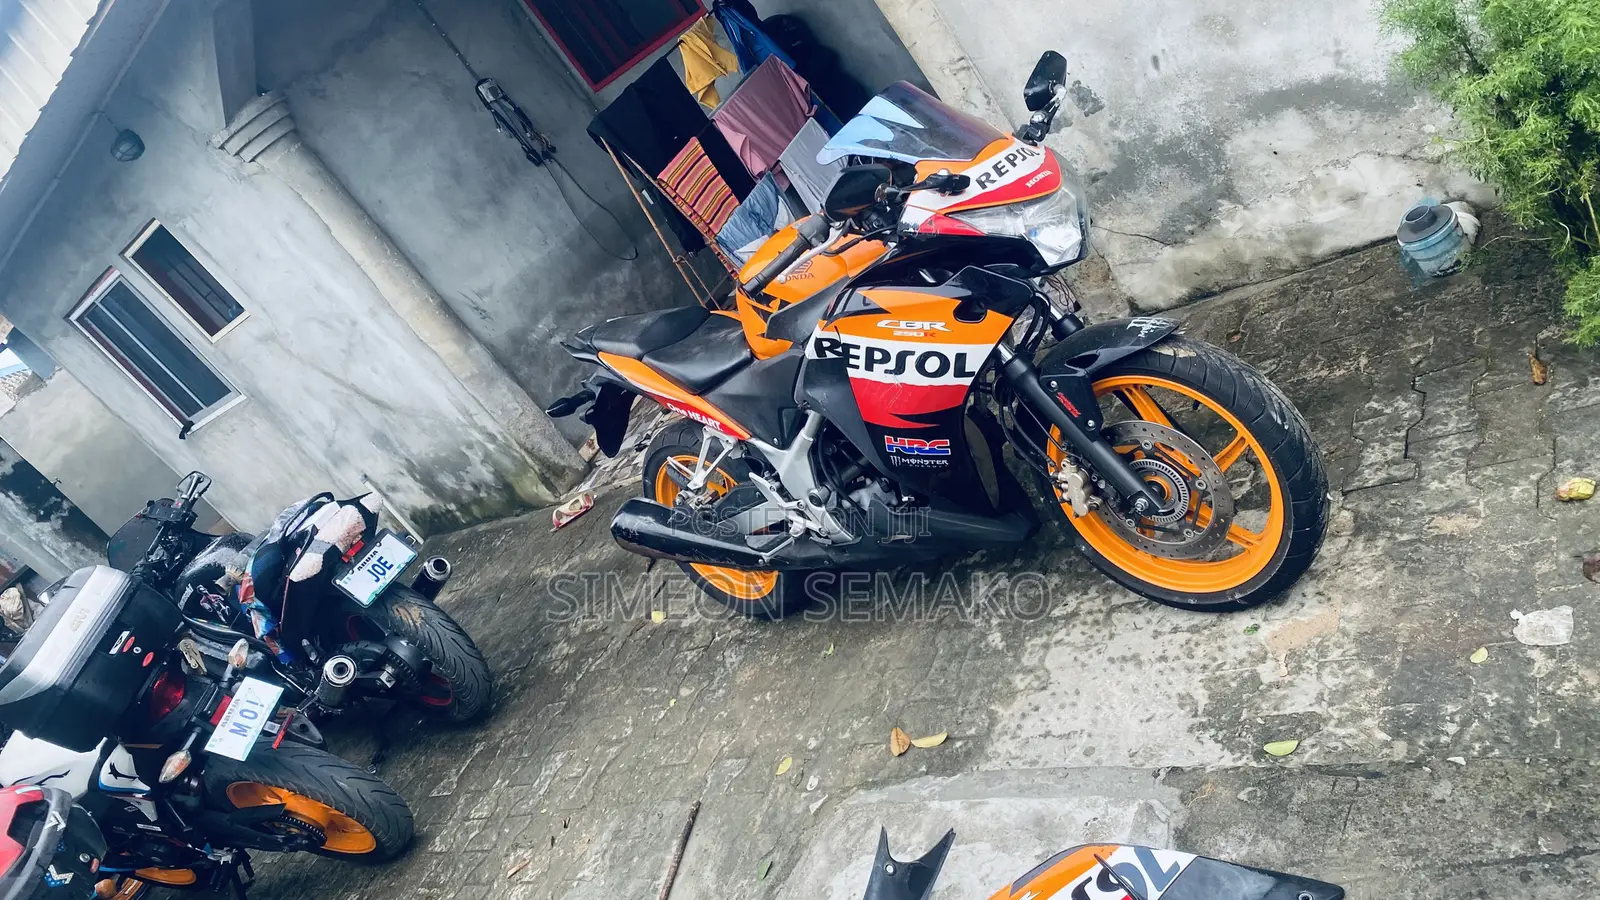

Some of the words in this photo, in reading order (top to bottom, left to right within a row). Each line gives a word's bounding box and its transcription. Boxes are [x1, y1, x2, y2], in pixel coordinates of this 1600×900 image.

[1025, 170, 1053, 188] HONDA
[876, 319, 954, 332] CBR
[813, 337, 976, 379] REPSOL
[884, 434, 952, 456] HRC
[901, 457, 949, 466] MONSTER
[366, 555, 394, 583] JOE
